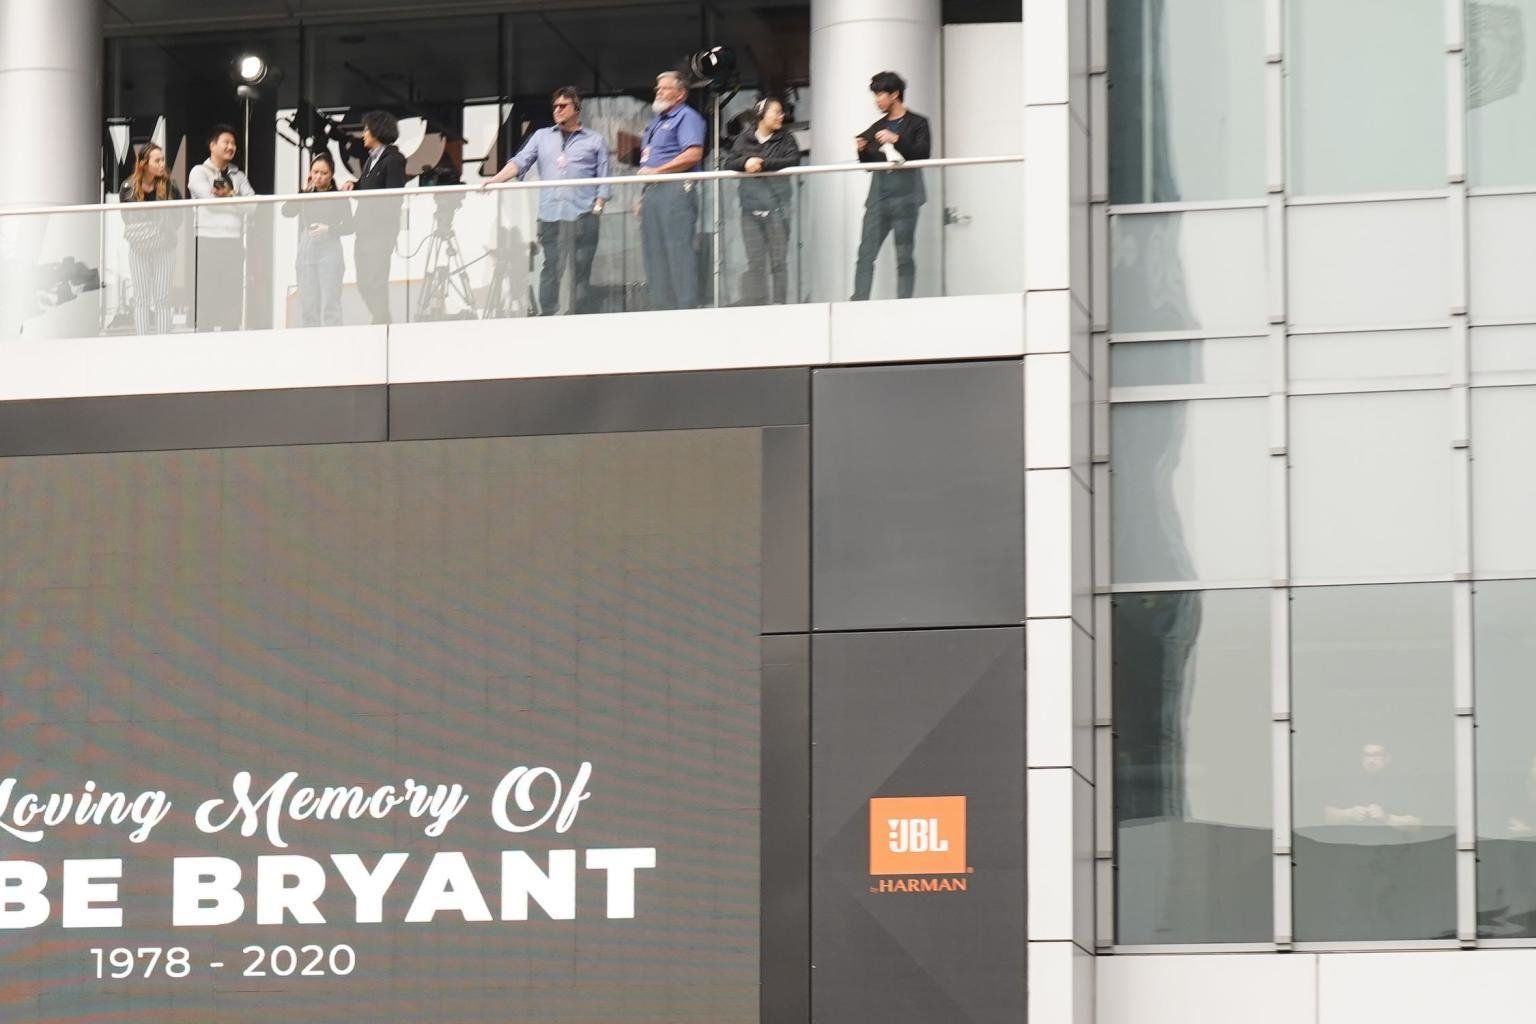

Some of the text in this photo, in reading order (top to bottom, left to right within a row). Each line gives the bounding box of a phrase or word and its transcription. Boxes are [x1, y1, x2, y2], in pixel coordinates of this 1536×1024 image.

[194, 771, 469, 848] Memory
[491, 761, 594, 834] Of
[887, 818, 948, 853] JBL
[172, 847, 657, 927] BRYANT
[879, 878, 967, 893] HARMAN
[89, 946, 191, 979] 1978
[242, 943, 356, 977] 2020
